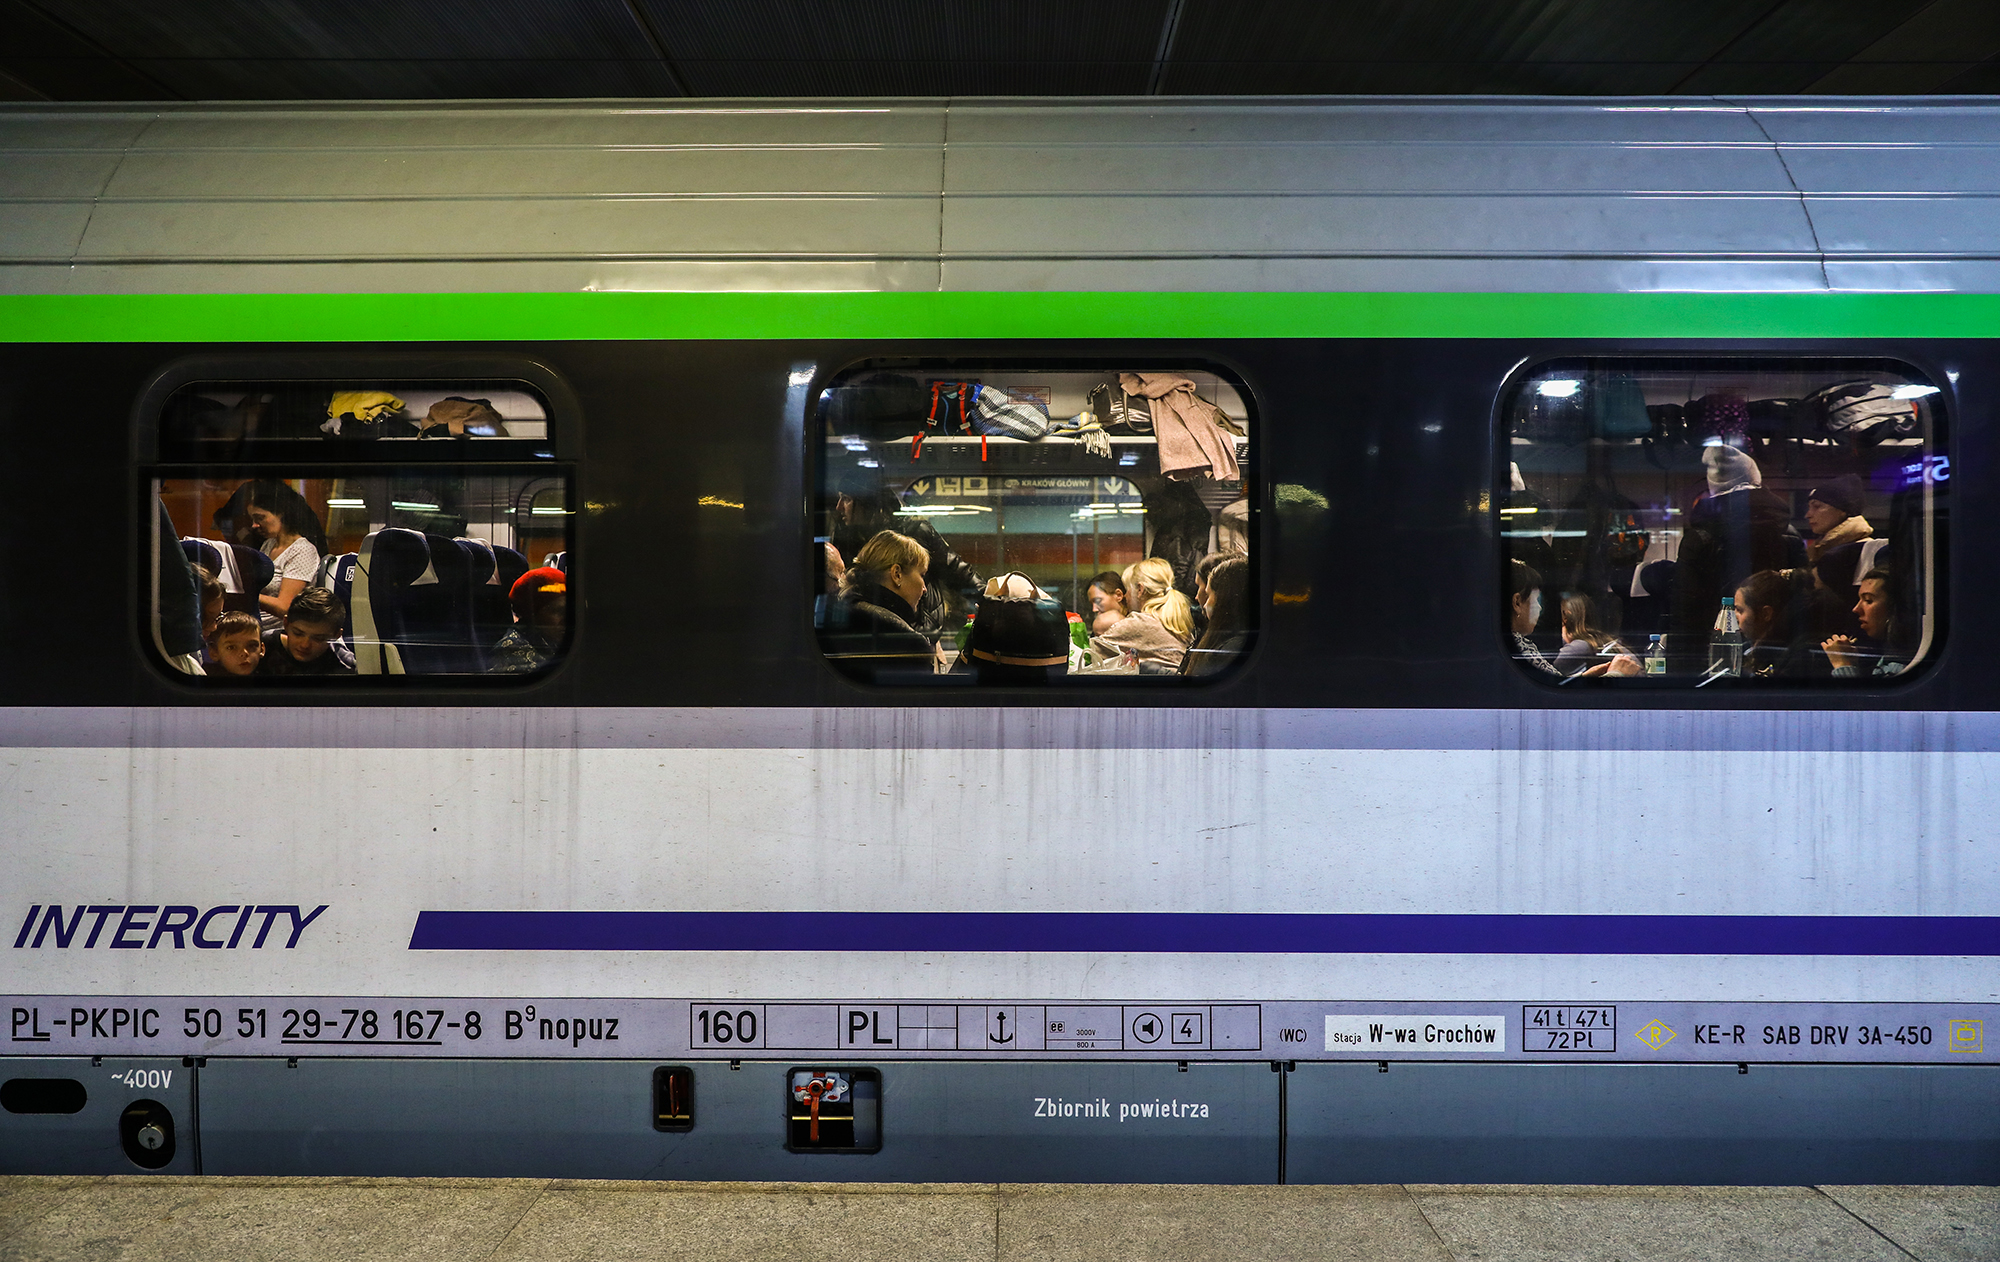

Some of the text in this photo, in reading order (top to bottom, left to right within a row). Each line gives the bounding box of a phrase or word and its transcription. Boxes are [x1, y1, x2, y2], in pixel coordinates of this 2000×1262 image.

[1021, 478, 1090, 488] KRAKÓW GŁÓWNY
[13, 904, 328, 949] INTERCITY
[12, 1009, 160, 1039] PL-PKPIC
[184, 1009, 222, 1038] 50
[238, 1009, 266, 1038] 51
[282, 1010, 379, 1040] 29-78
[394, 1010, 482, 1040] 167-8
[698, 1010, 757, 1044] 160
[848, 1010, 893, 1044] PL
[1050, 1022, 1064, 1032] ee
[1533, 1009, 1550, 1027] 41
[1575, 1010, 1598, 1028] 47
[1181, 1019, 1193, 1038] 4
[1279, 1028, 1308, 1044] (WC)
[1333, 1023, 1496, 1046] Stacja W-wa Grochów
[1650, 1026, 1662, 1044] R
[1694, 1025, 1932, 1046] KE-R SAB DRV 3A-450
[1076, 1041, 1096, 1049] 800 A
[1034, 1097, 1209, 1123] Zbiornik powietrza
